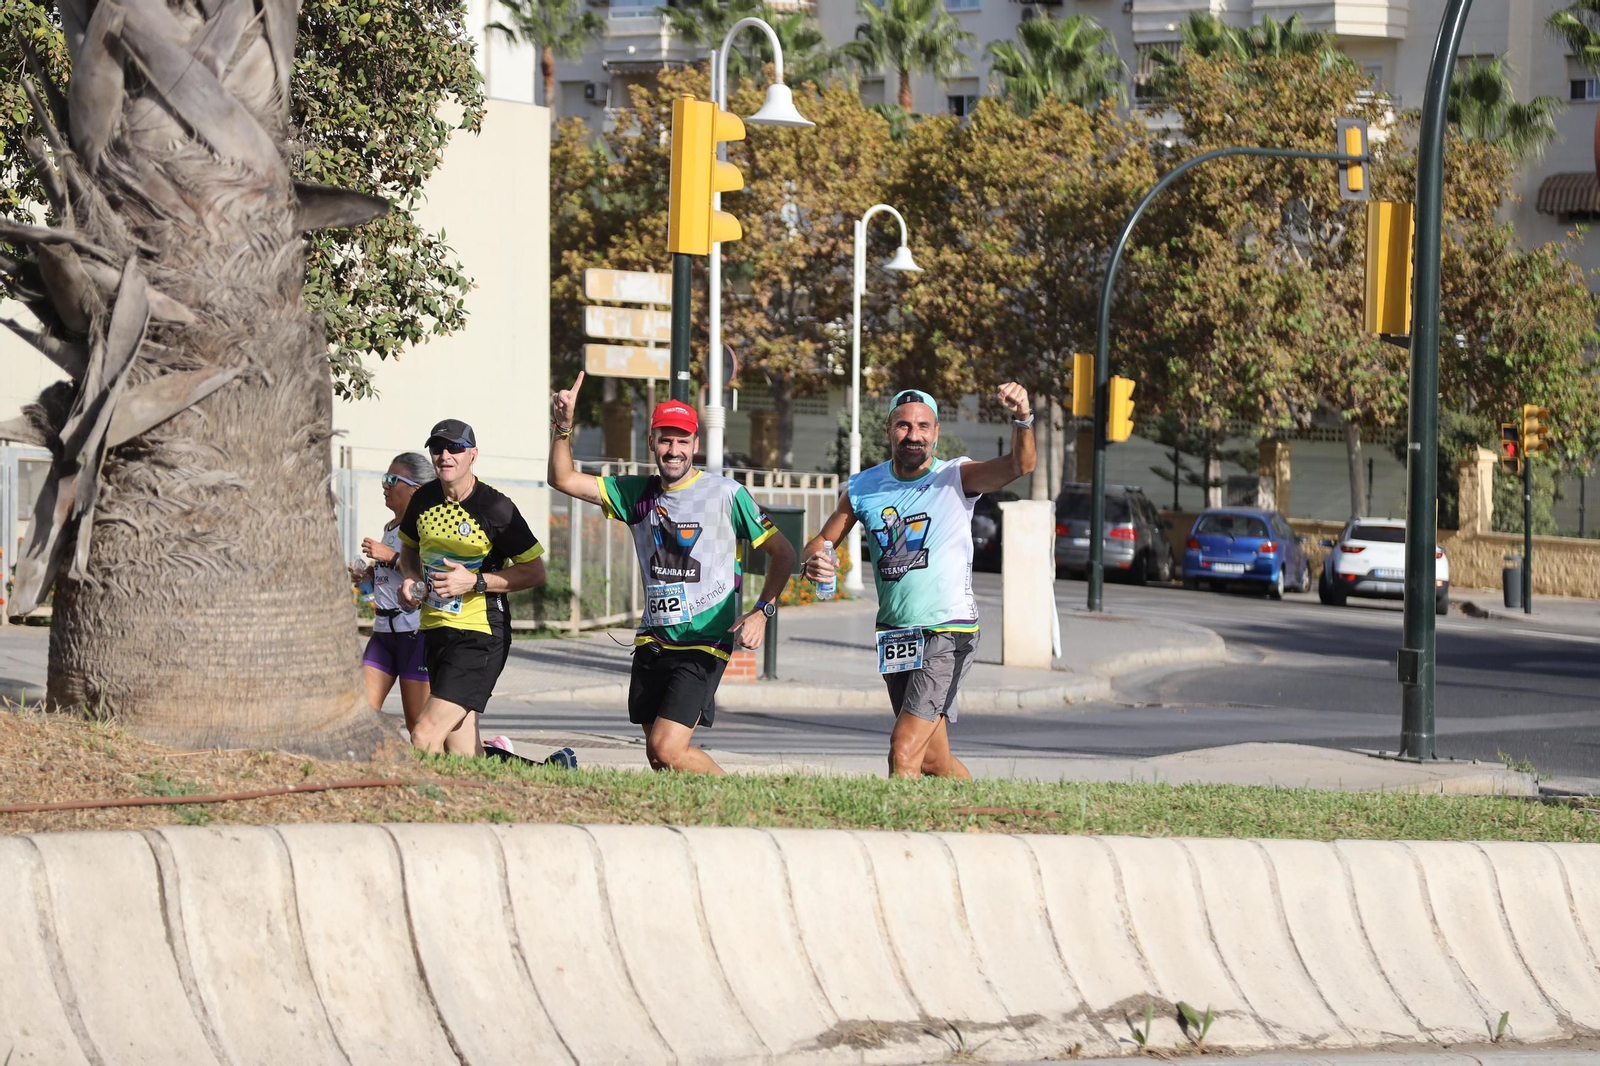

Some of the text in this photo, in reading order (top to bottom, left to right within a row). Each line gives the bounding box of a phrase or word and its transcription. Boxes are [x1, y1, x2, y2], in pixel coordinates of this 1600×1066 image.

[695, 596, 707, 608] se
[706, 580, 727, 600] rinde
[649, 597, 681, 614] 642
[885, 642, 917, 660] 625
